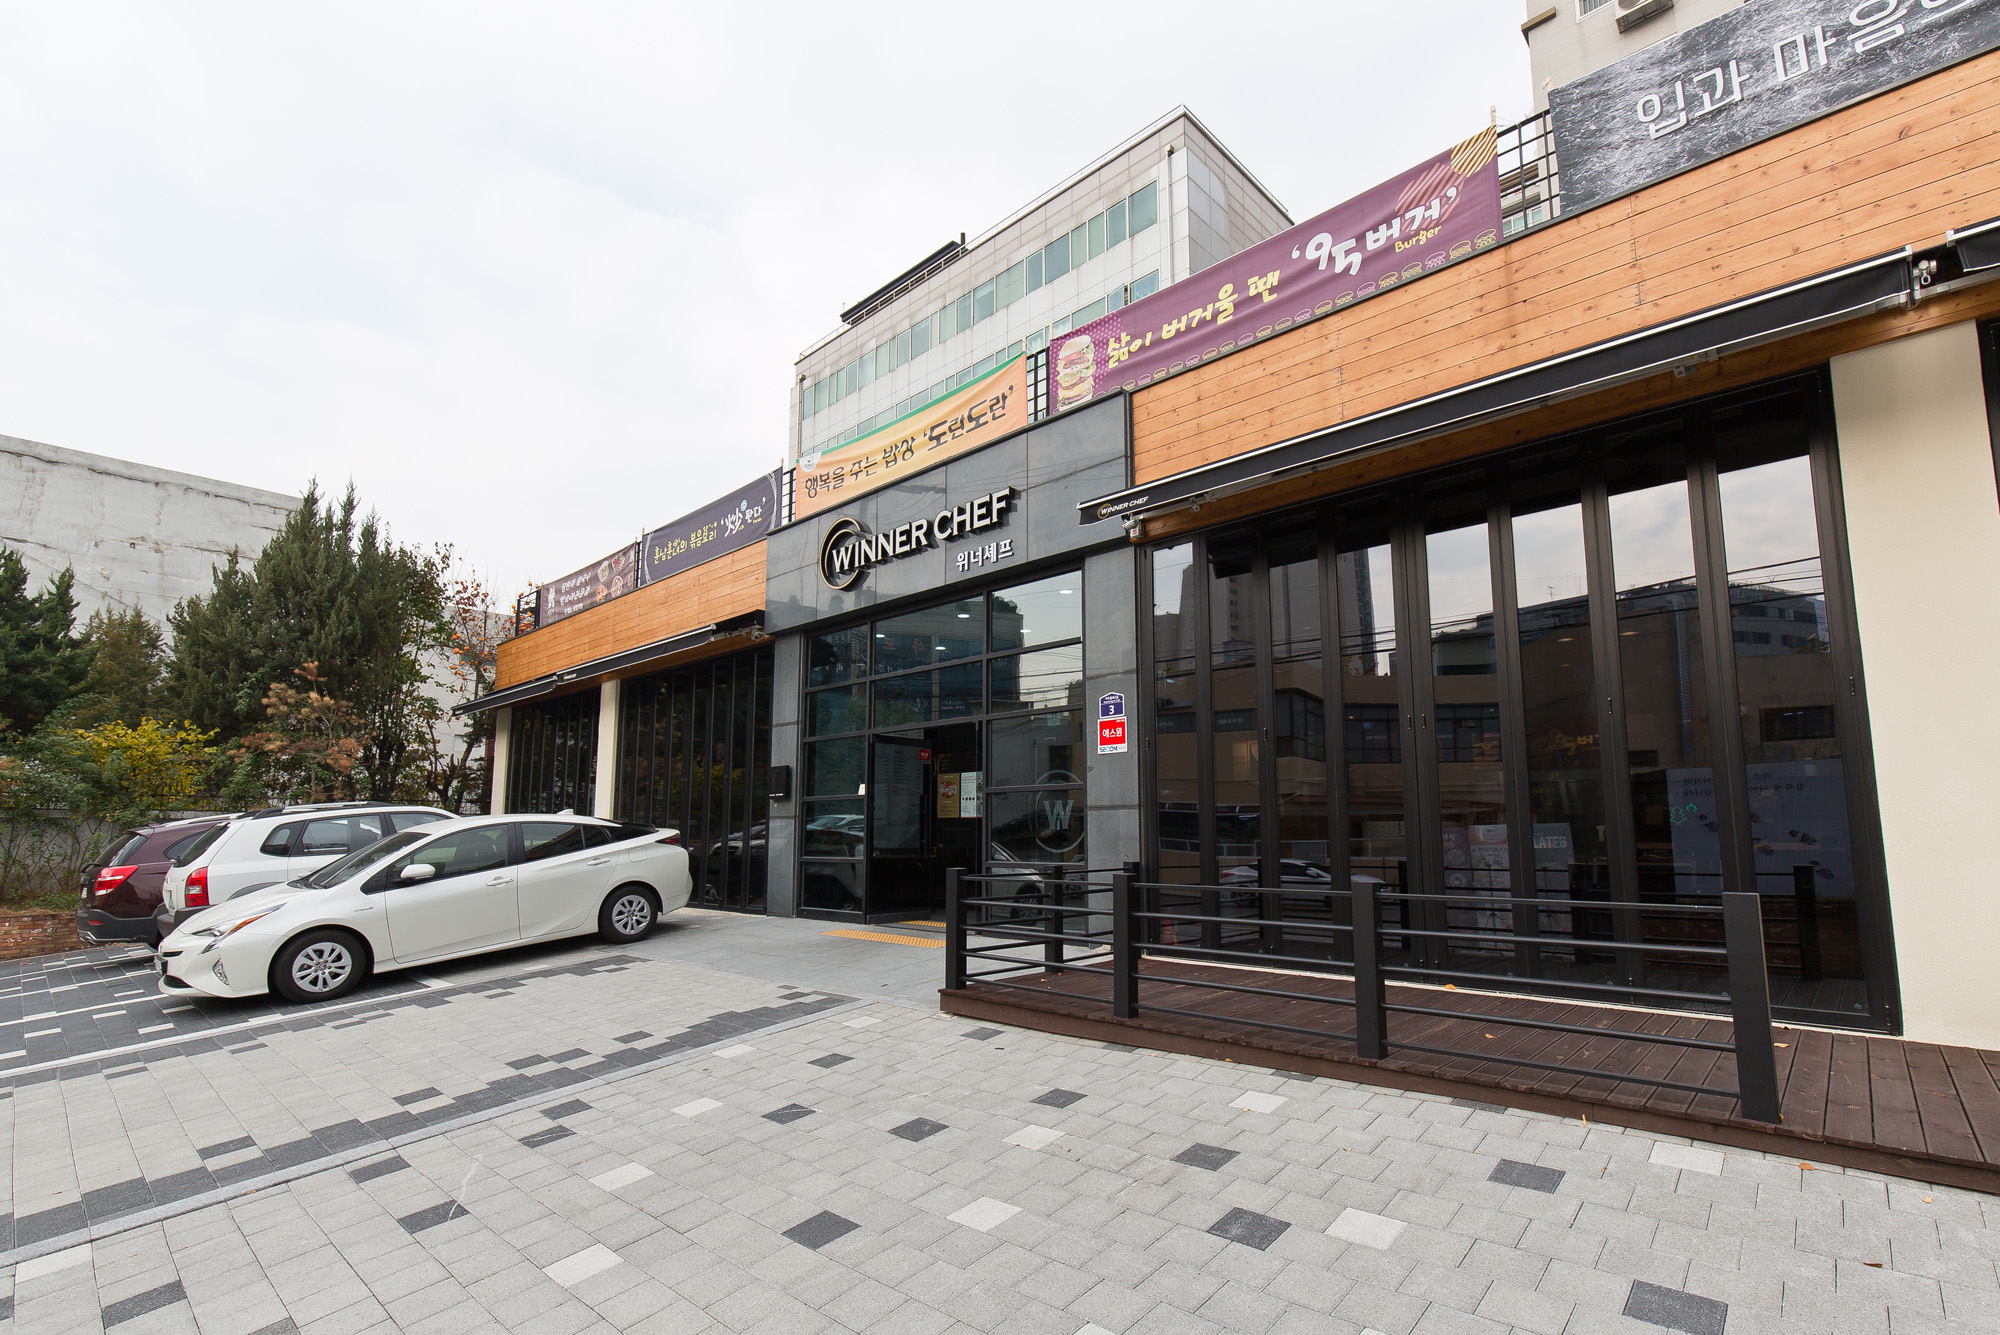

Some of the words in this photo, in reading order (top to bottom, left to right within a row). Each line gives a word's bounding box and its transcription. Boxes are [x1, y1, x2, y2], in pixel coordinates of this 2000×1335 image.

[1636, 59, 1750, 140] 입과
[1773, 0, 1980, 83] 마음
[1394, 225, 1442, 253] Burger
[1108, 331, 1152, 369] 삶이
[1161, 283, 1239, 340] 버거울
[1247, 269, 1281, 303] 땐
[804, 466, 845, 499] 행복을
[849, 456, 878, 482] 주는
[882, 436, 916, 469] 밥상
[1100, 502, 1128, 515] WINNER
[1128, 496, 1149, 507] CHEF
[690, 526, 717, 550] 볶음요리
[832, 517, 930, 573] WINNER
[933, 486, 1012, 541] CHEF
[955, 538, 1014, 572] 위너셰프
[1108, 705, 1115, 715] 3
[1102, 726, 1123, 738] 에스원
[1099, 745, 1118, 753] SECOM
[1043, 799, 1075, 831] W
